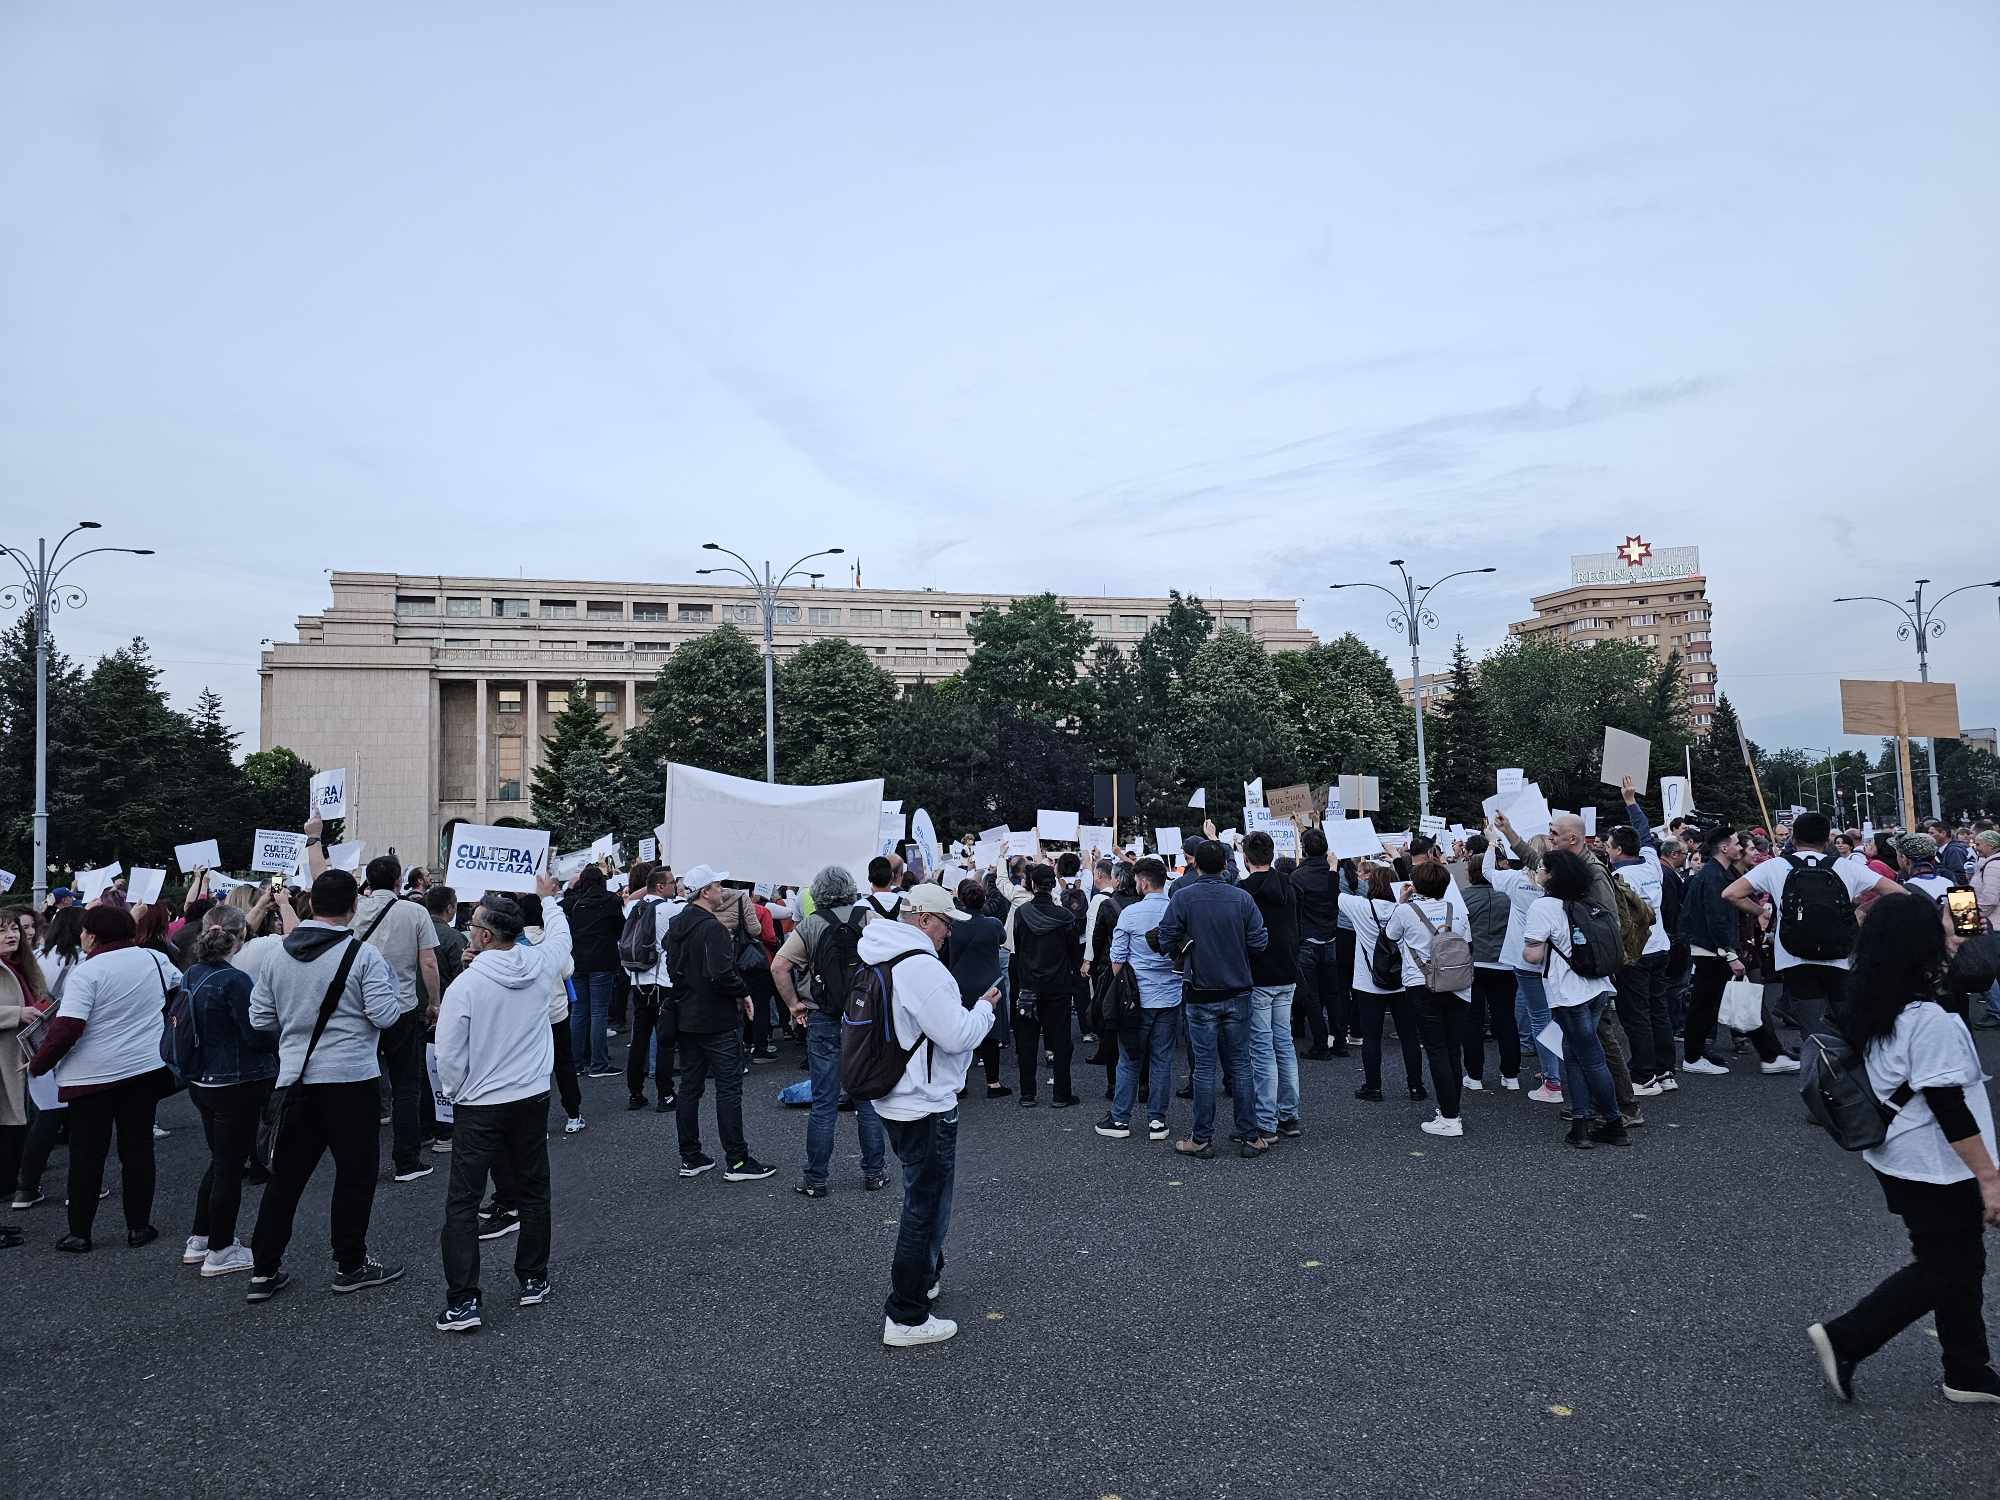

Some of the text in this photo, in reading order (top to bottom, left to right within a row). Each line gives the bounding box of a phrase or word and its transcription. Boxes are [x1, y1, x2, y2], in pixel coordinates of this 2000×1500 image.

[1576, 563, 1696, 583] REGINA MARIA
[457, 844, 532, 864] CULTURA
